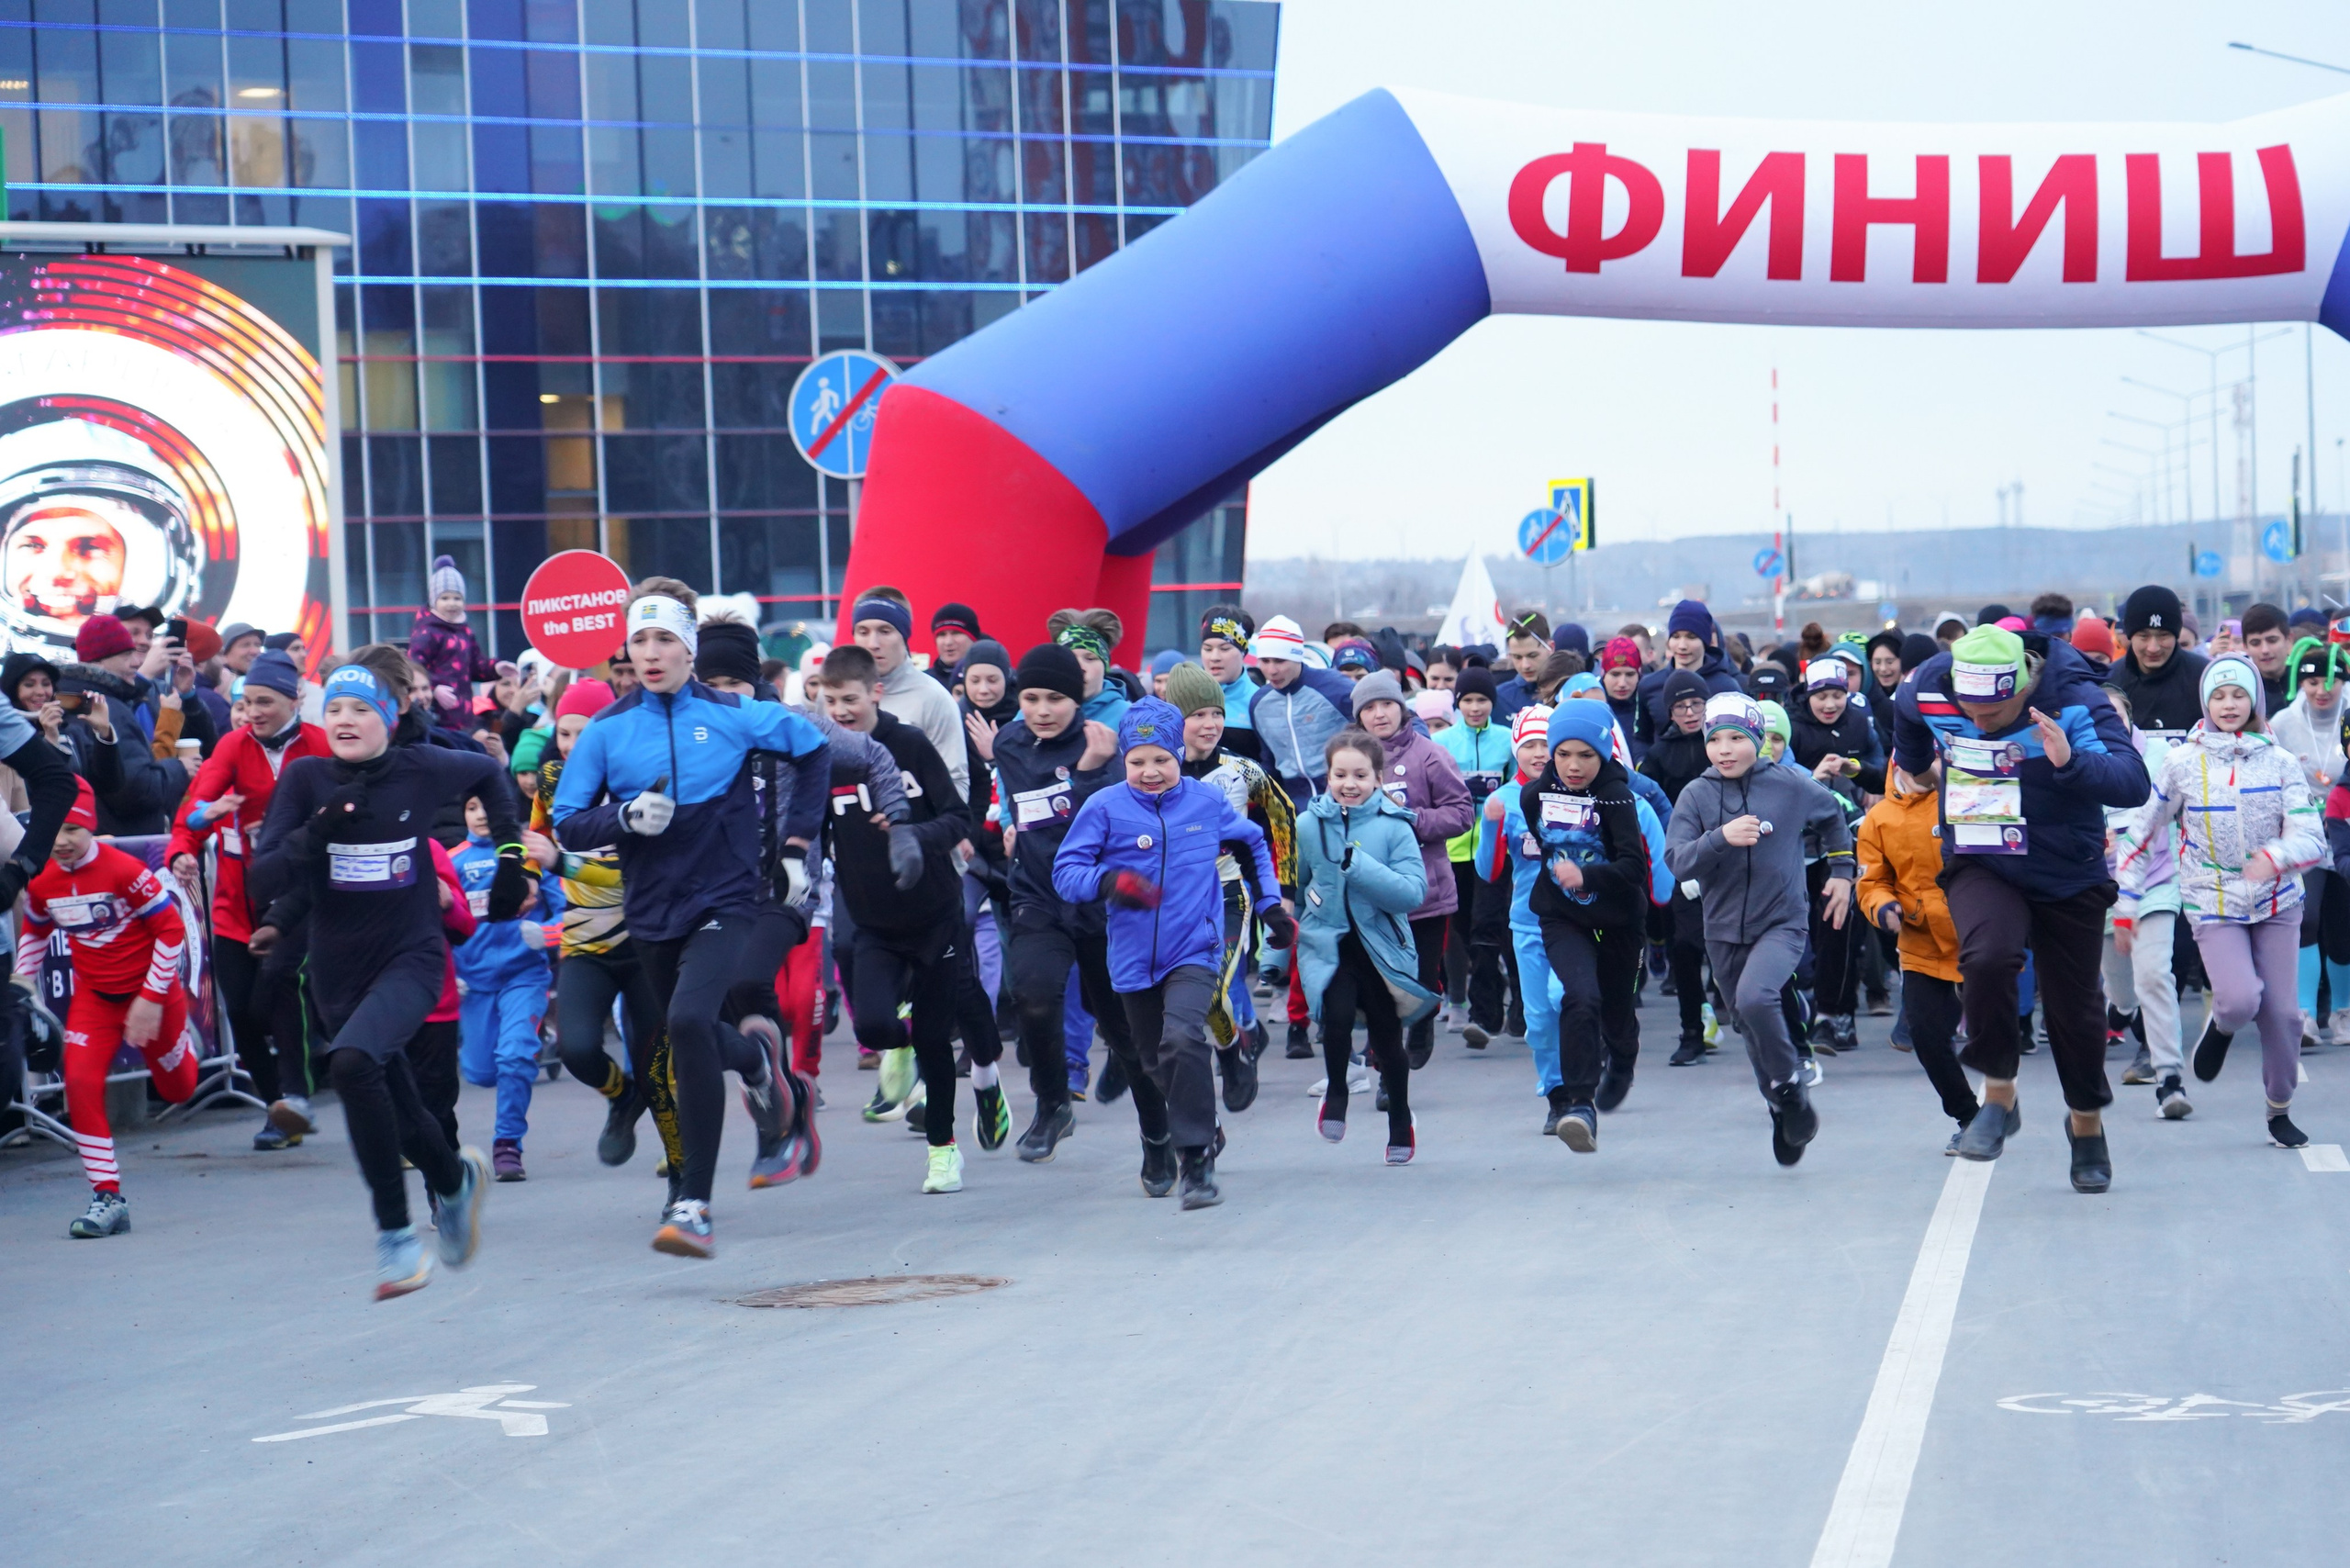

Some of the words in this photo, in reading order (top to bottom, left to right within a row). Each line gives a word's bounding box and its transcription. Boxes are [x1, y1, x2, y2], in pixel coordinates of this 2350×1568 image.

[1507, 141, 2306, 284] ФИНИШ
[527, 588, 628, 615] ЛИКСТАНОВ
[543, 620, 569, 636] the
[572, 612, 616, 633] BEST
[831, 770, 923, 816] FIA
